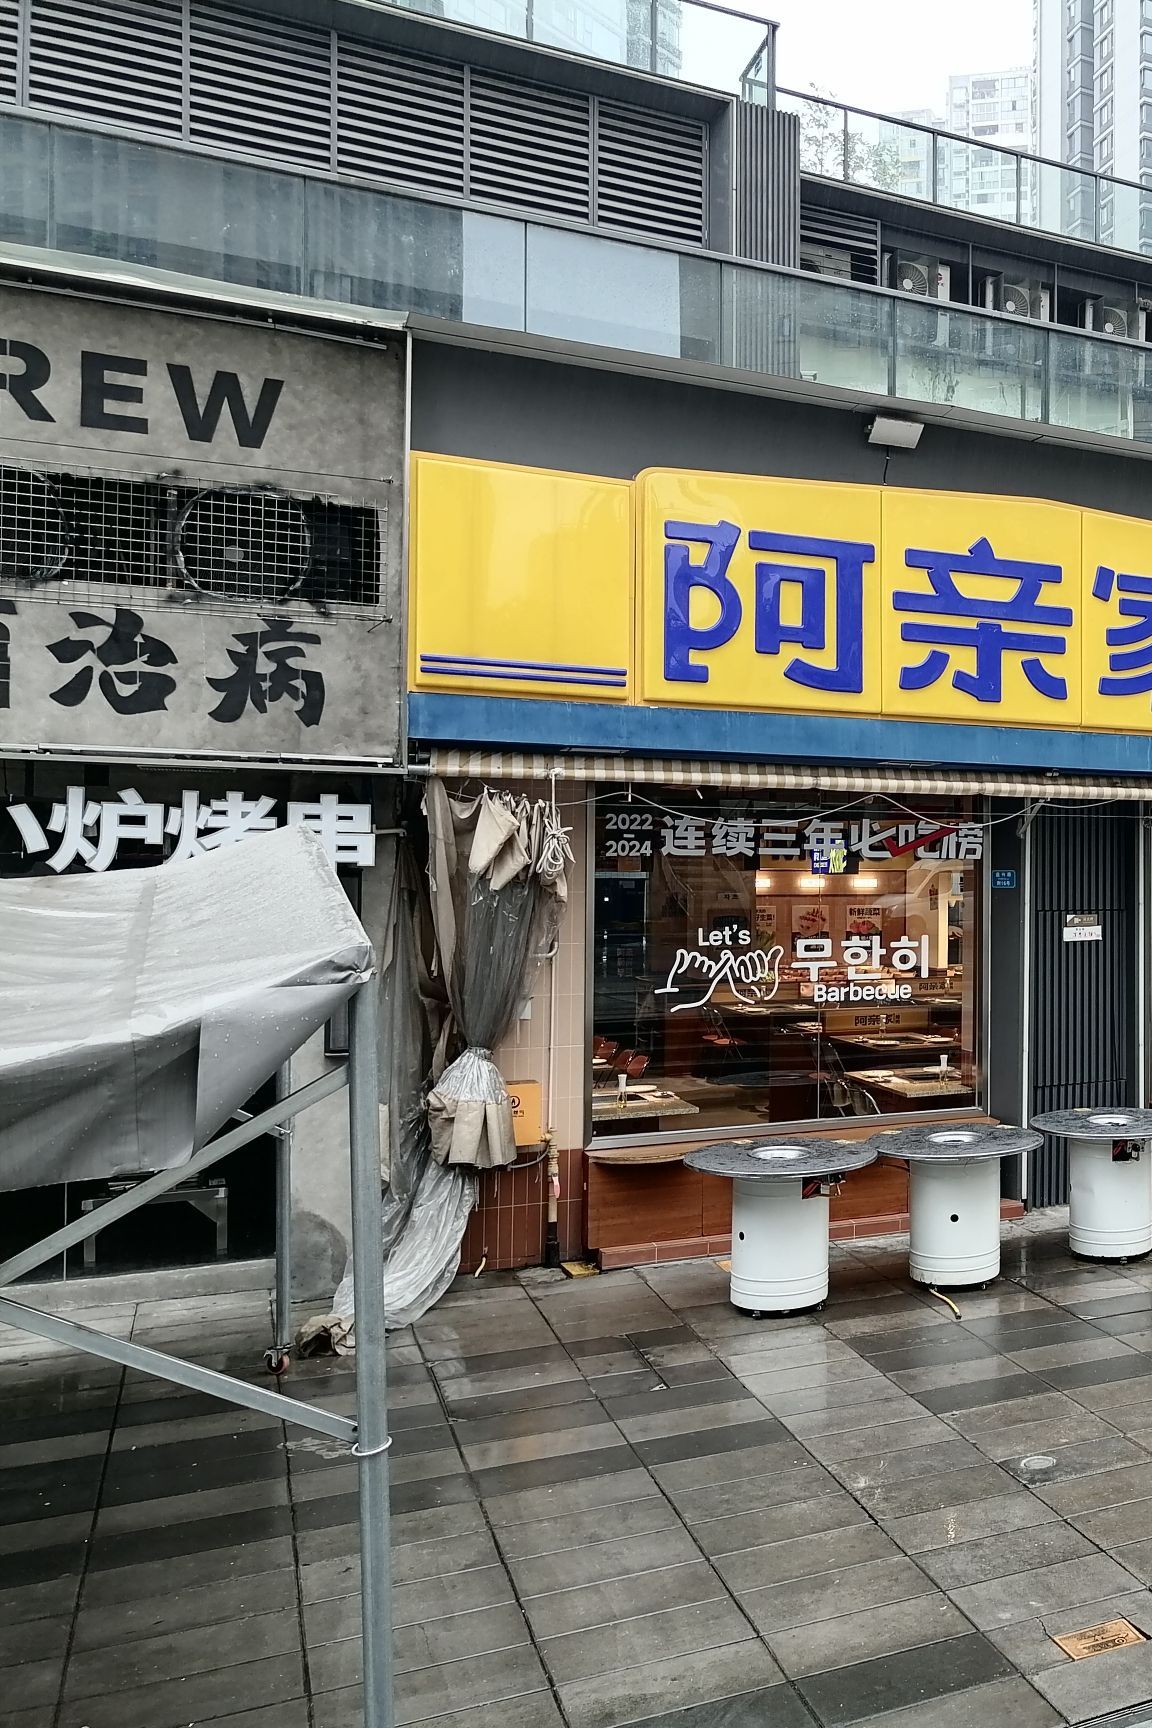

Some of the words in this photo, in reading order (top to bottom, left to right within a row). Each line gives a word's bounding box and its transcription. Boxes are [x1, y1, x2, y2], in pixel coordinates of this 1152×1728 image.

[0, 338, 284, 449] REW
[0, 601, 326, 728] 治病
[605, 813, 654, 830] 2022
[660, 815, 984, 860] 连续三年必吃榜
[605, 840, 653, 857] 2024
[698, 925, 751, 947] Let's
[791, 934, 930, 982] 무한히
[813, 983, 912, 1003] Barbecue
